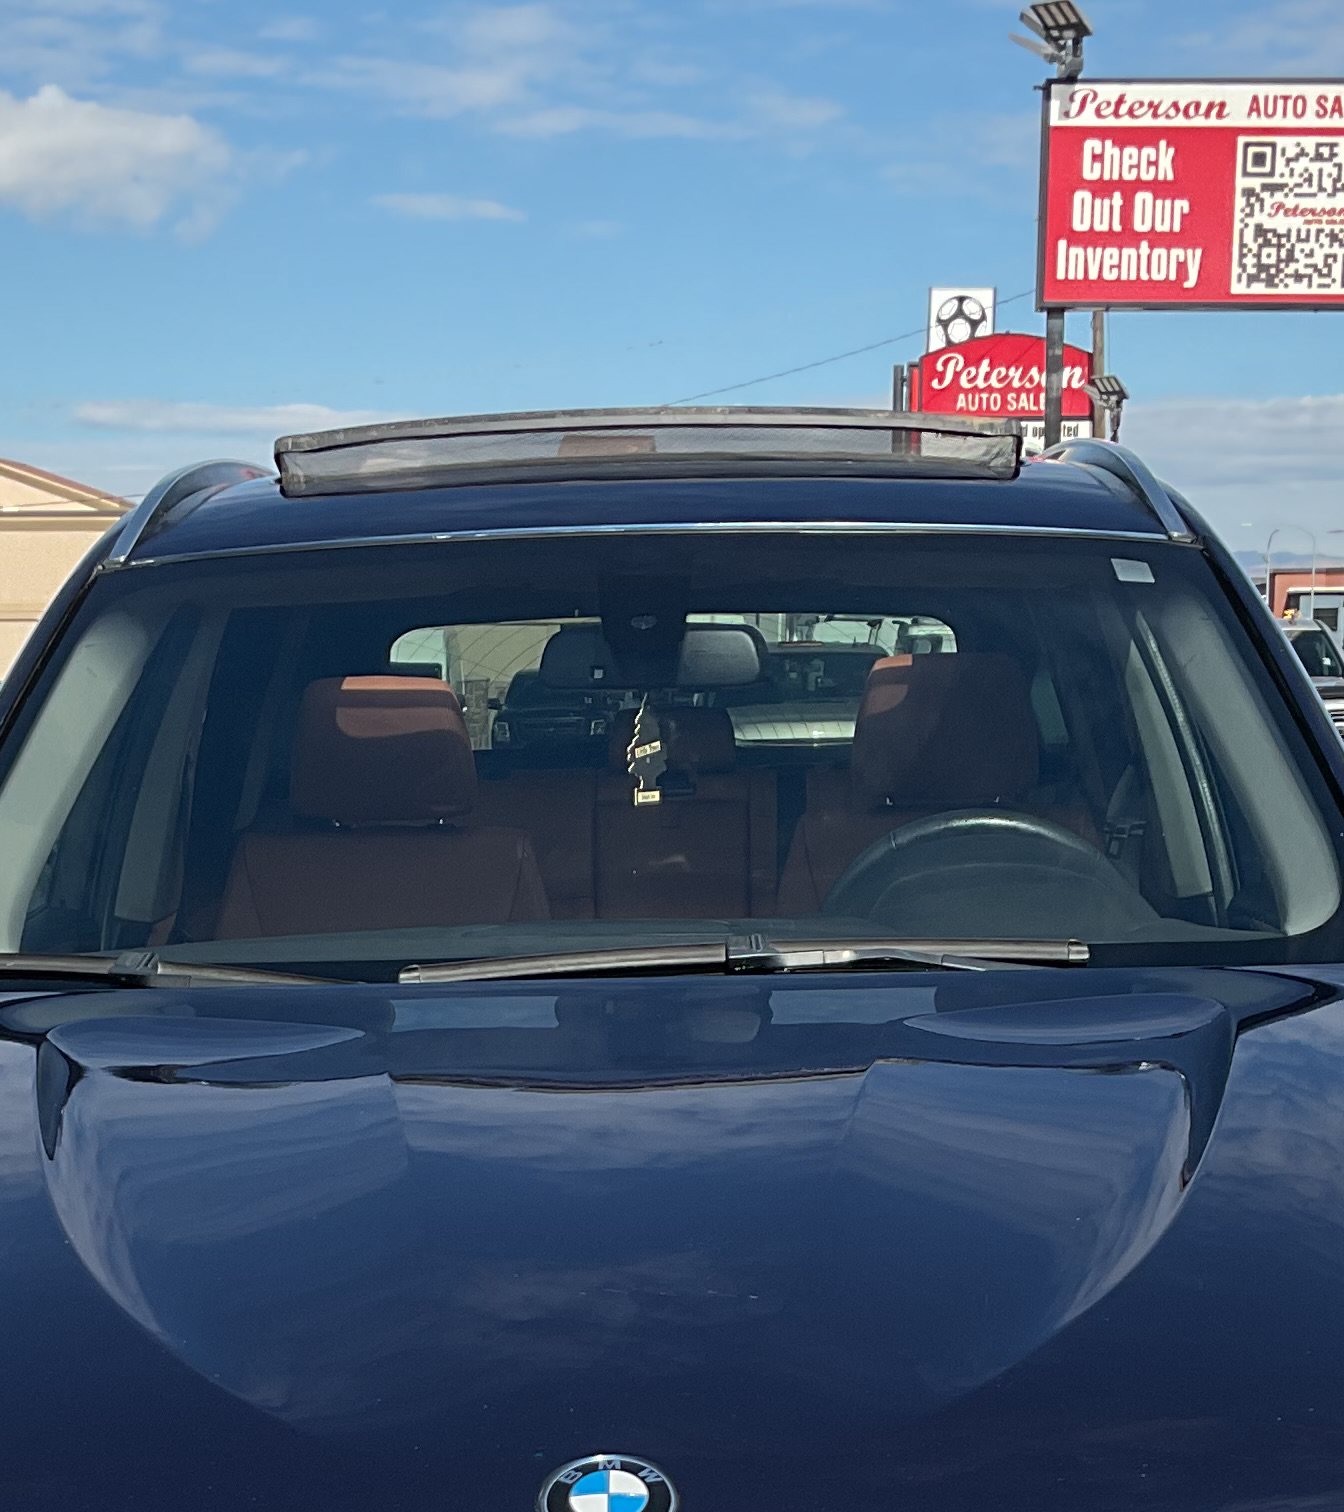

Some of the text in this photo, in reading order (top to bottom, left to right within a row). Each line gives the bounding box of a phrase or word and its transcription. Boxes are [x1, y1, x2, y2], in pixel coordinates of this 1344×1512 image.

[1063, 88, 1231, 121] Peterson
[1247, 94, 1307, 120] AUTO
[1082, 138, 1175, 181] Check
[1072, 189, 1190, 233] Out Our
[1056, 239, 1203, 289] Inventory
[931, 353, 1086, 390] Petersn
[956, 393, 1046, 412] AUTO SALE
[557, 1459, 665, 1485] BMW
